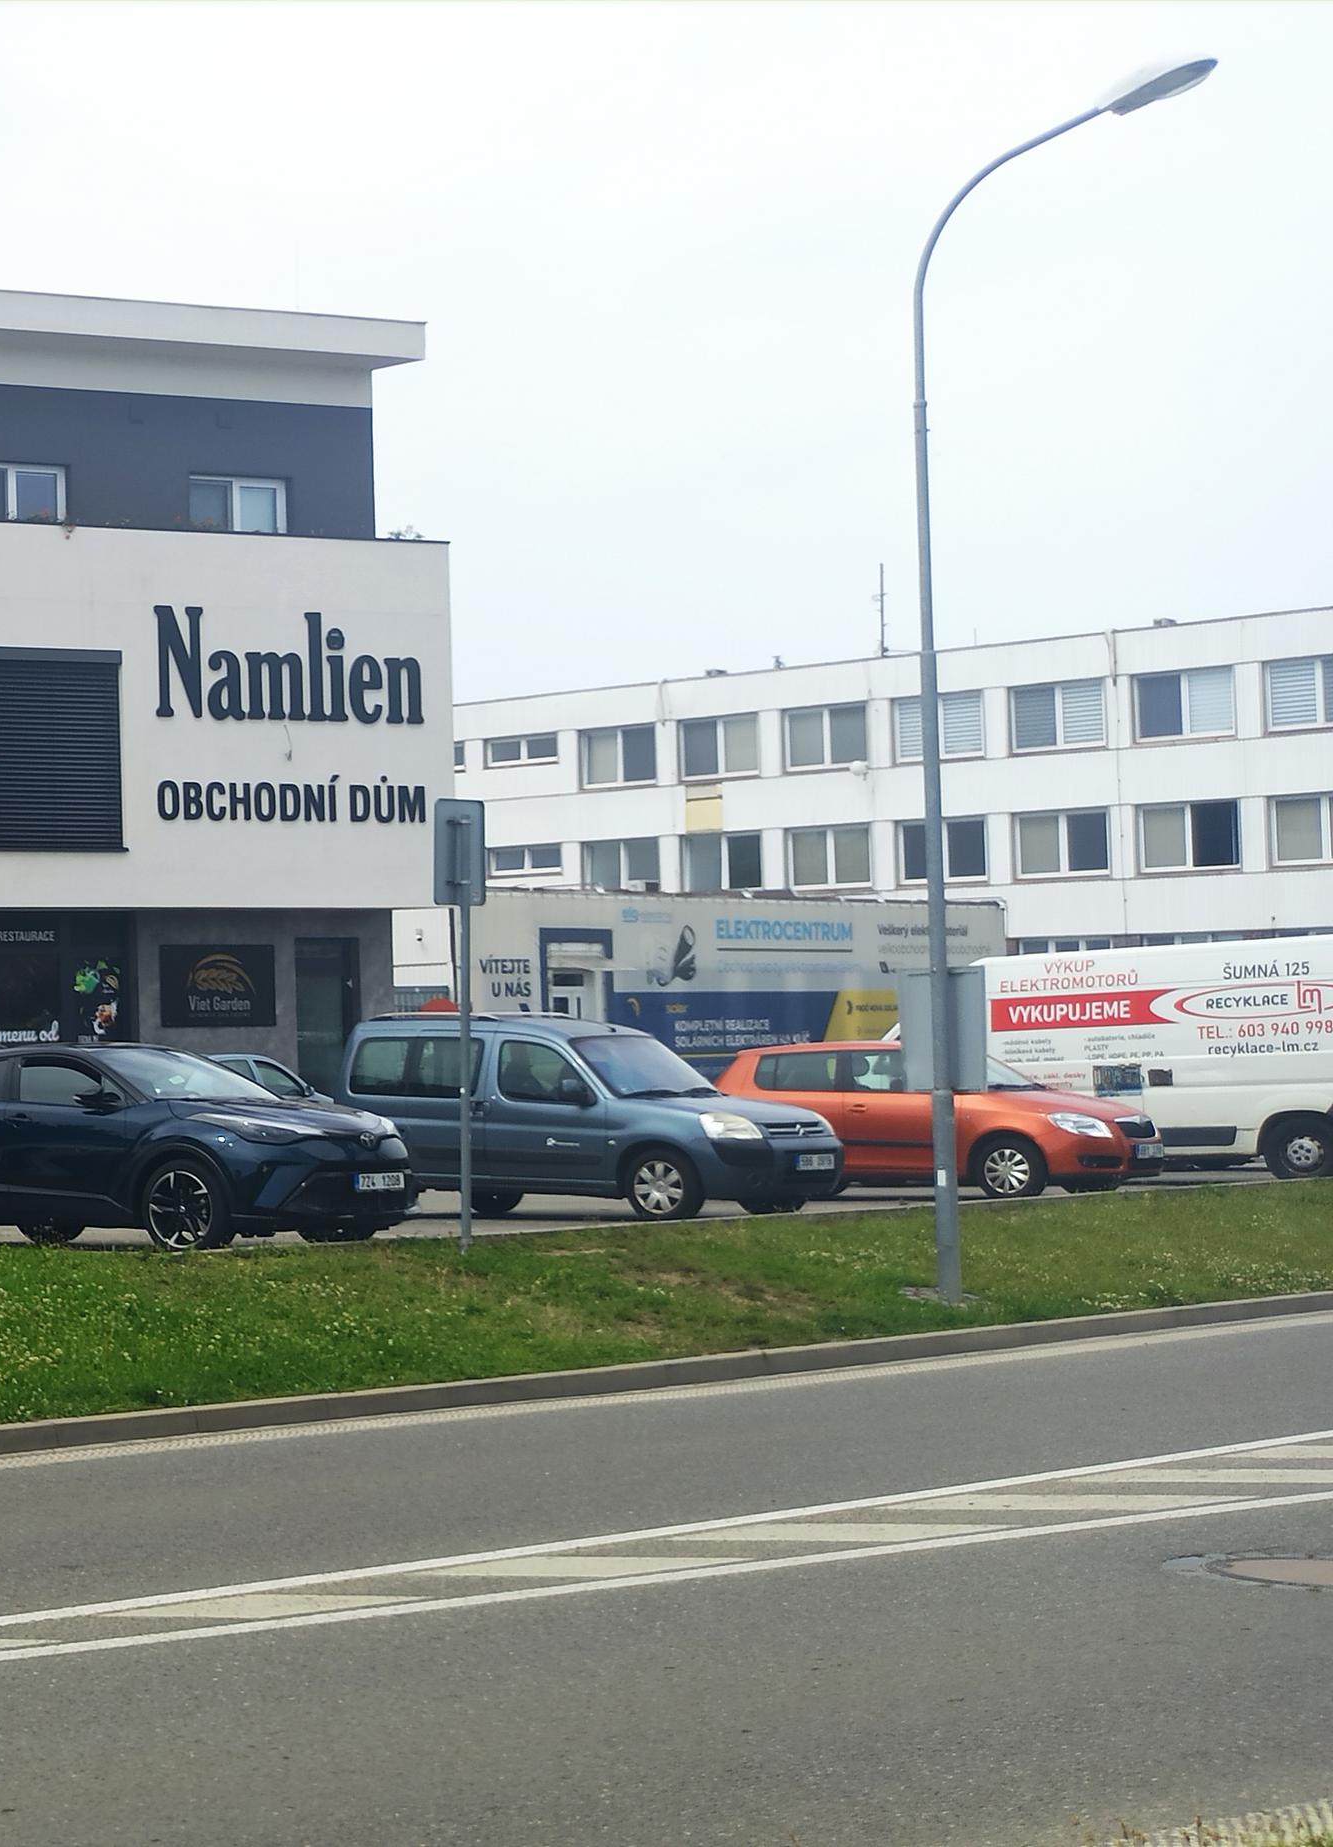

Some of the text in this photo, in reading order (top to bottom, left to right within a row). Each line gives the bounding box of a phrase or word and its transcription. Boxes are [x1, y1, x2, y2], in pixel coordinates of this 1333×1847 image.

[153, 604, 425, 724] Namlien
[157, 774, 427, 823] OBCHODNÍ DŮM
[716, 919, 854, 941] ELEKTROCENTRUM
[479, 954, 531, 974] VÍTEJTE
[1044, 959, 1095, 975] VÝKUP
[1222, 960, 1310, 980] ŠUMNÁ 125
[491, 979, 532, 998] U NÁS
[999, 969, 1139, 993] ELEKTROMOTORŮ
[189, 995, 251, 1011] Viet Garden
[1205, 993, 1289, 1010] RECYKLACE
[1008, 1000, 1131, 1024] VYKUPUJEME
[39, 1020, 60, 1042] od
[674, 1017, 771, 1032] KOMPLETNÍ REALIZACE
[1197, 1019, 1333, 1040] TEL.: 603 940 998
[1084, 1044, 1109, 1052] PLASTY
[1207, 1040, 1320, 1057] recyklace-lm.cz
[360, 1176, 376, 1188] 7Z4
